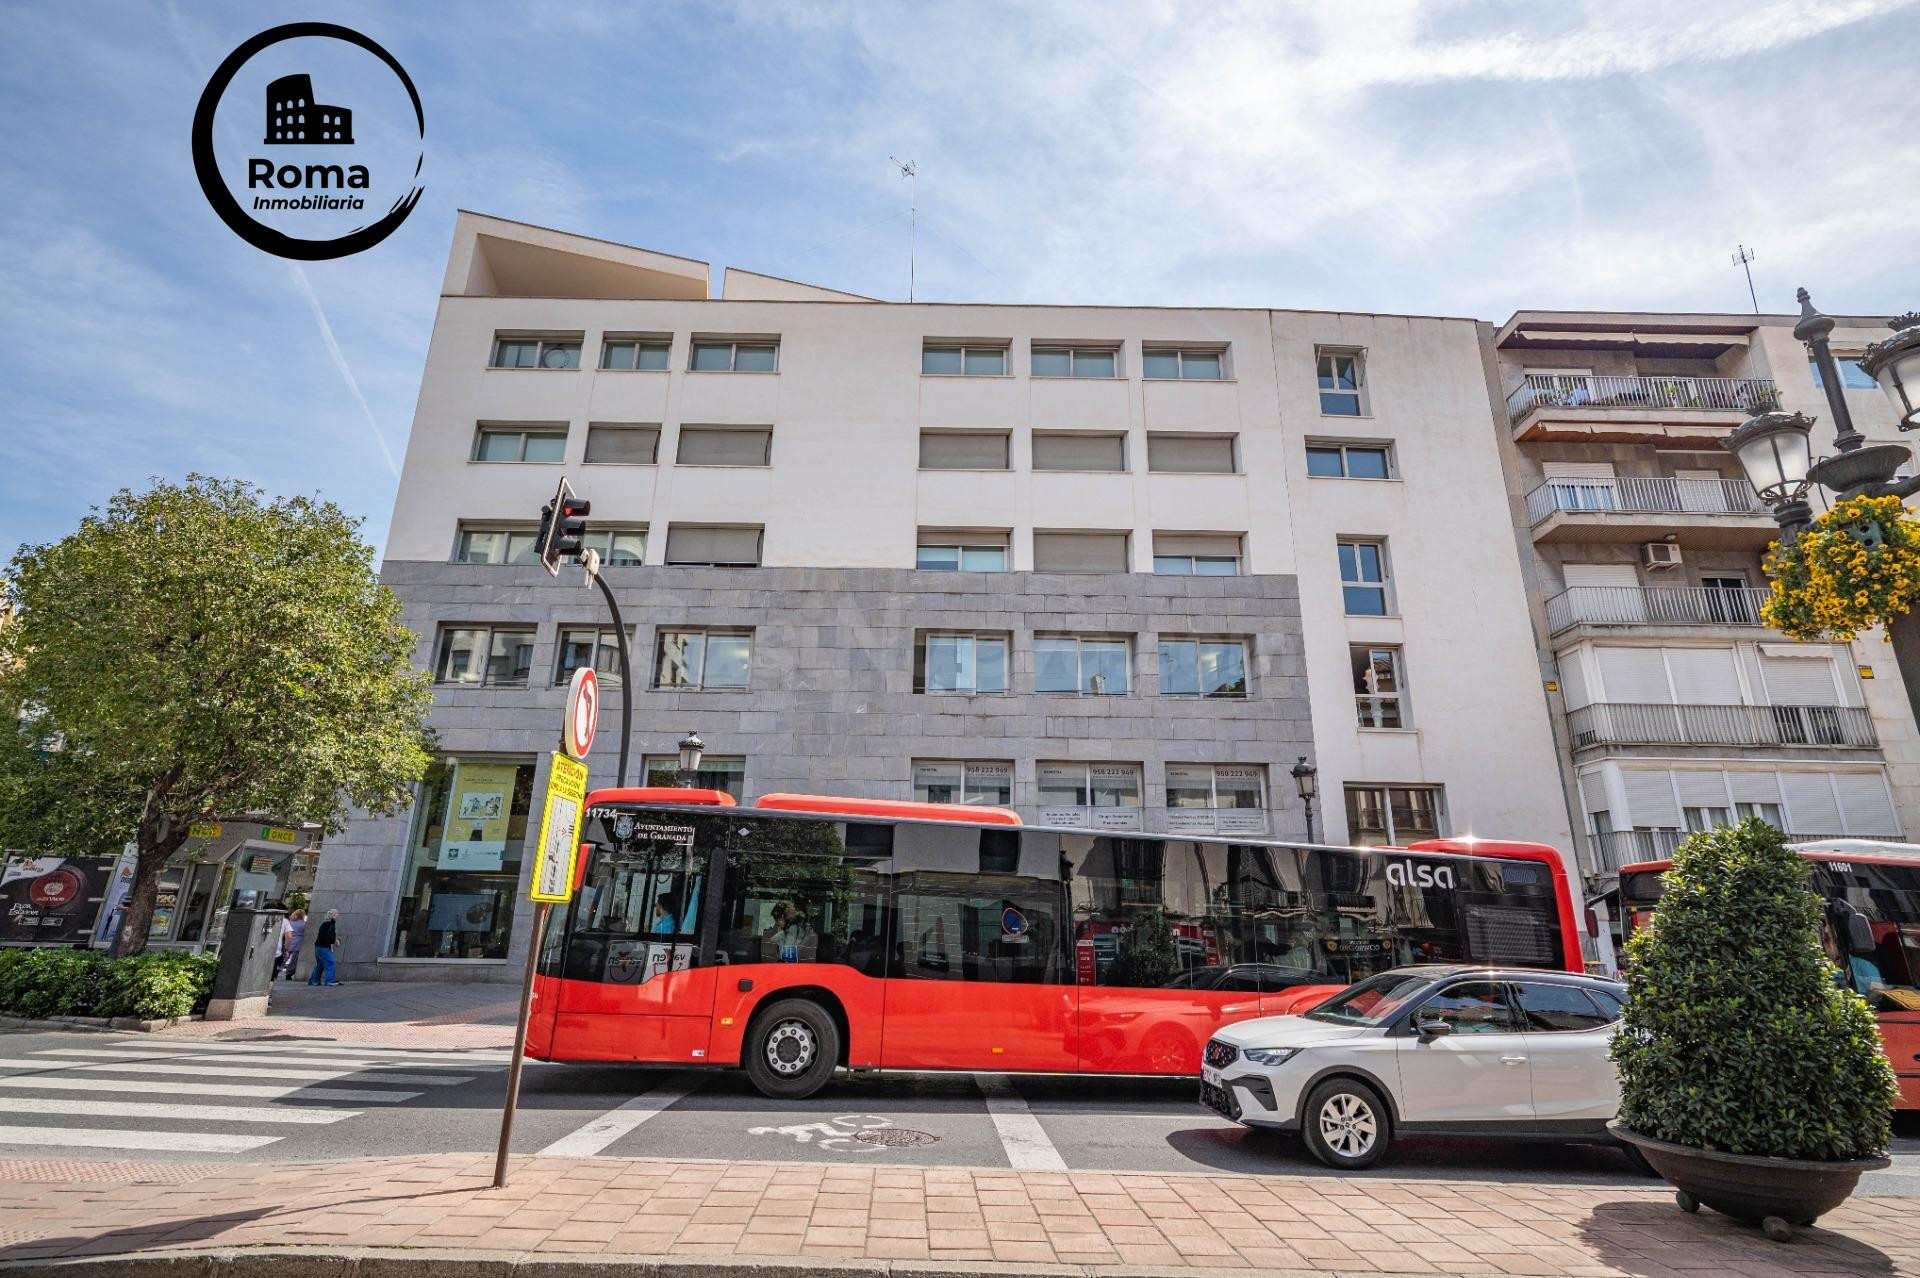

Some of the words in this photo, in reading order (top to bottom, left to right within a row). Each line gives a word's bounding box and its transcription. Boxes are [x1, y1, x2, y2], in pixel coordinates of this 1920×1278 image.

[556, 761, 584, 780] ATENCIÓN
[585, 807, 617, 819] 11734
[271, 832, 294, 841] ONCE
[1828, 861, 1853, 873] 11601
[1386, 859, 1454, 889] alsa
